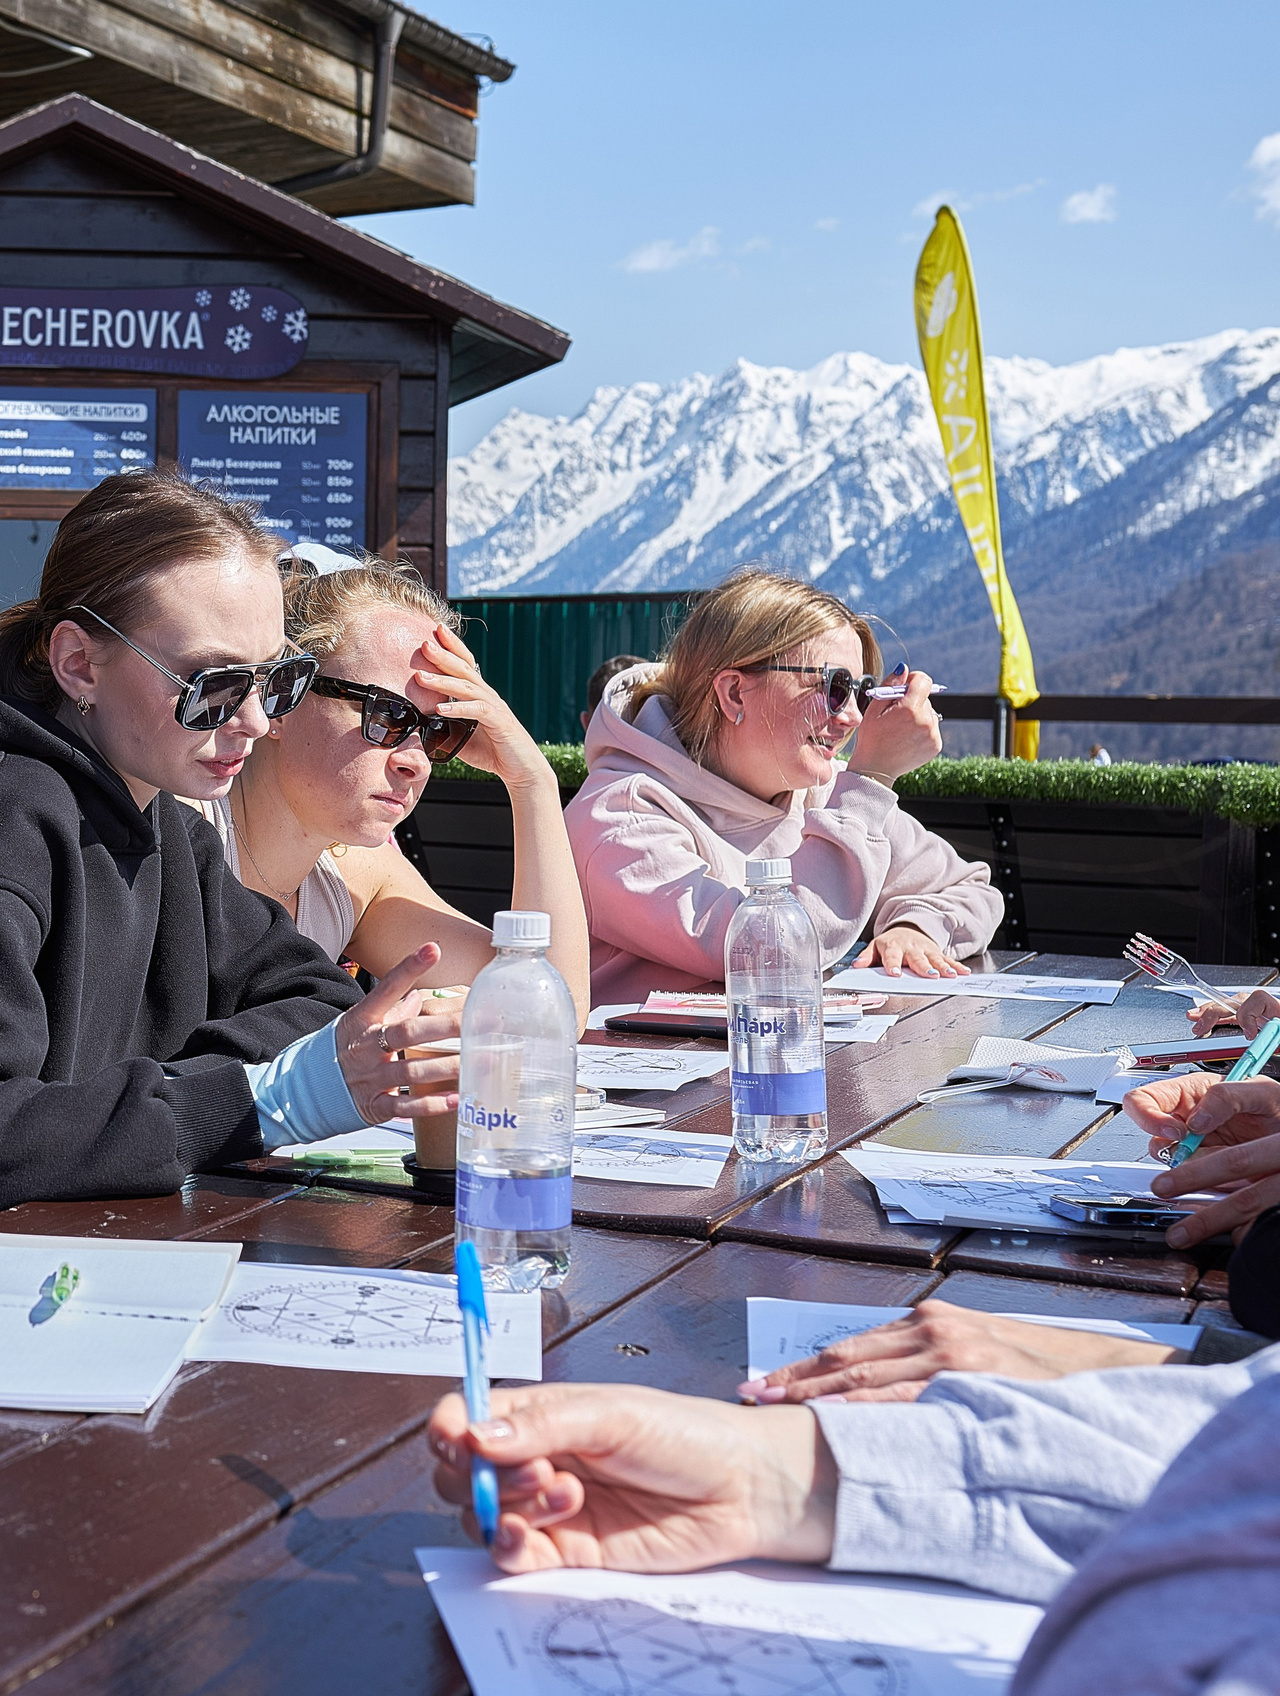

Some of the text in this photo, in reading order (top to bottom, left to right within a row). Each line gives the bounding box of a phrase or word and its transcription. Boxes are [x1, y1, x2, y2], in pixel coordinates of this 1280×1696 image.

[83, 405, 140, 418] НАПИТКИ
[206, 404, 340, 425] АЛКОГОЛЬНЫЕ
[230, 426, 316, 445] НАПИТКИ
